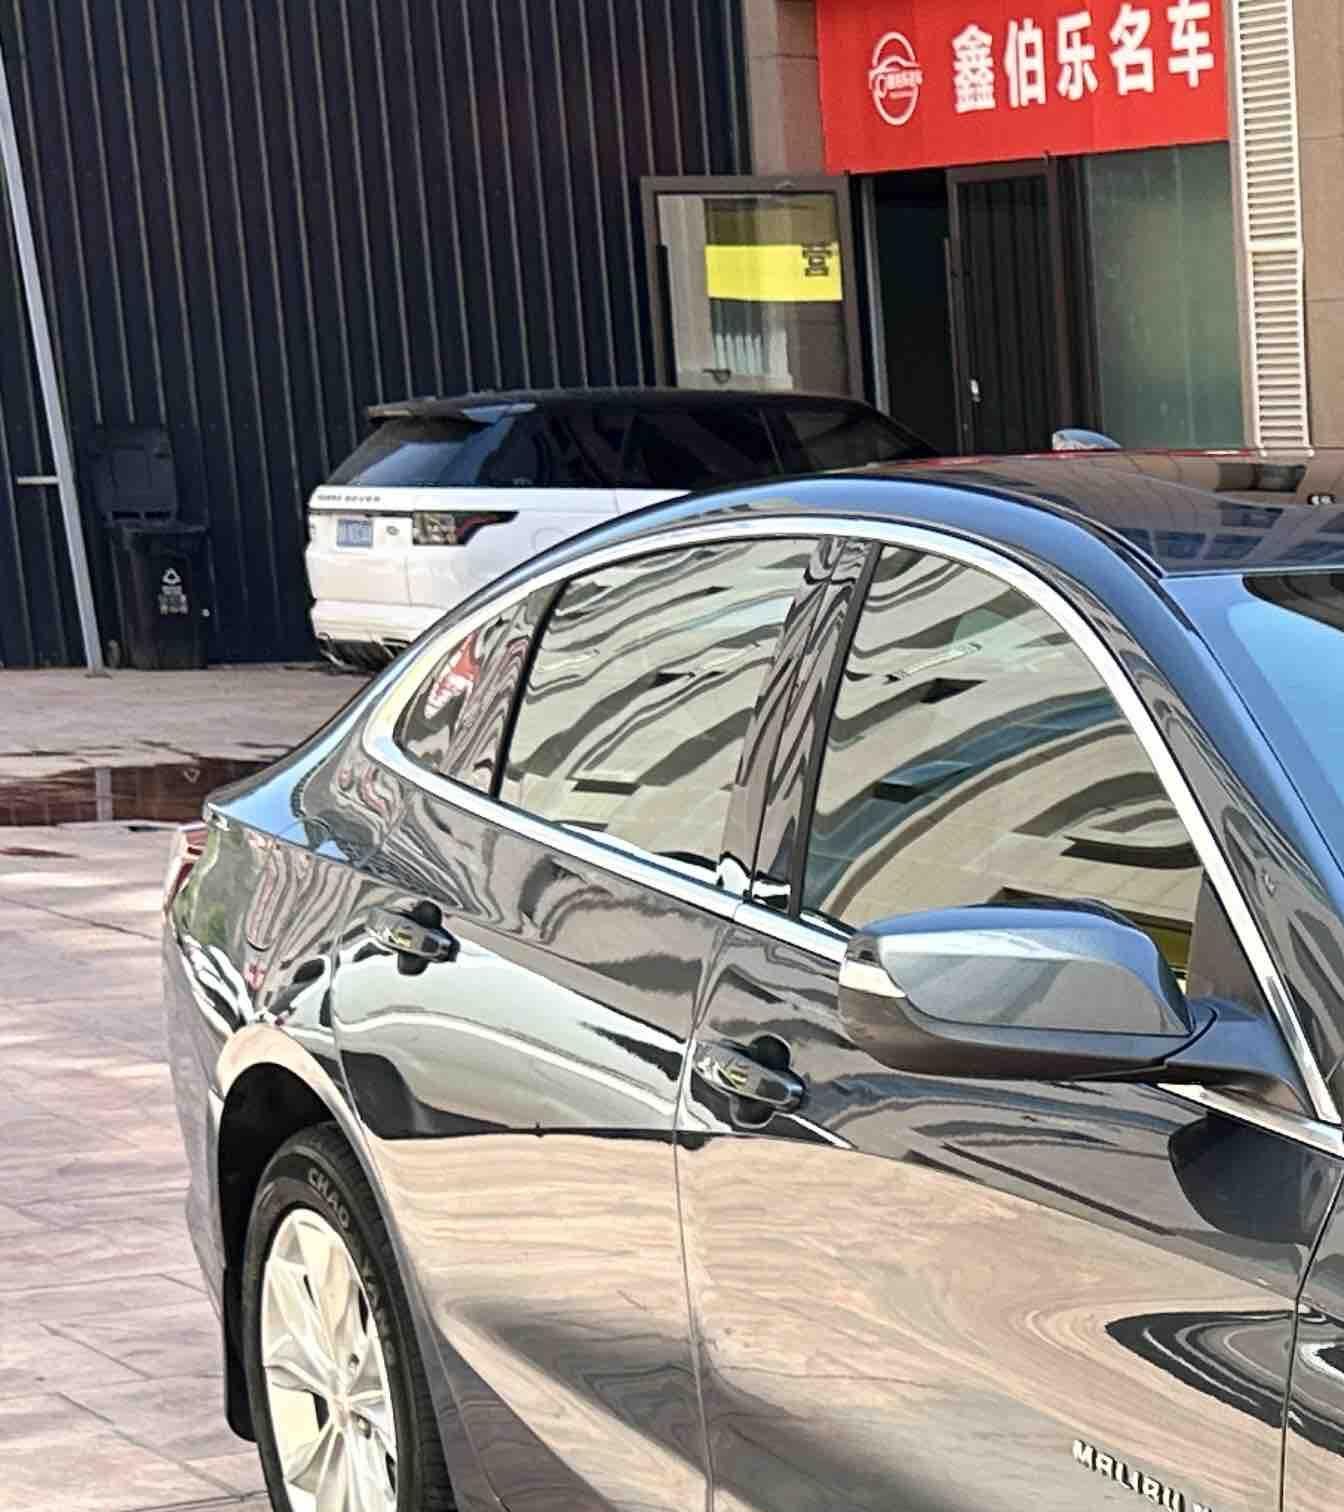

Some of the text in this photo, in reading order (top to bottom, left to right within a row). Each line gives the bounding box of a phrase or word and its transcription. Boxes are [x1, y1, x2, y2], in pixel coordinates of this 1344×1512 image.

[951, 0, 1214, 113] 鑫伯乐名车
